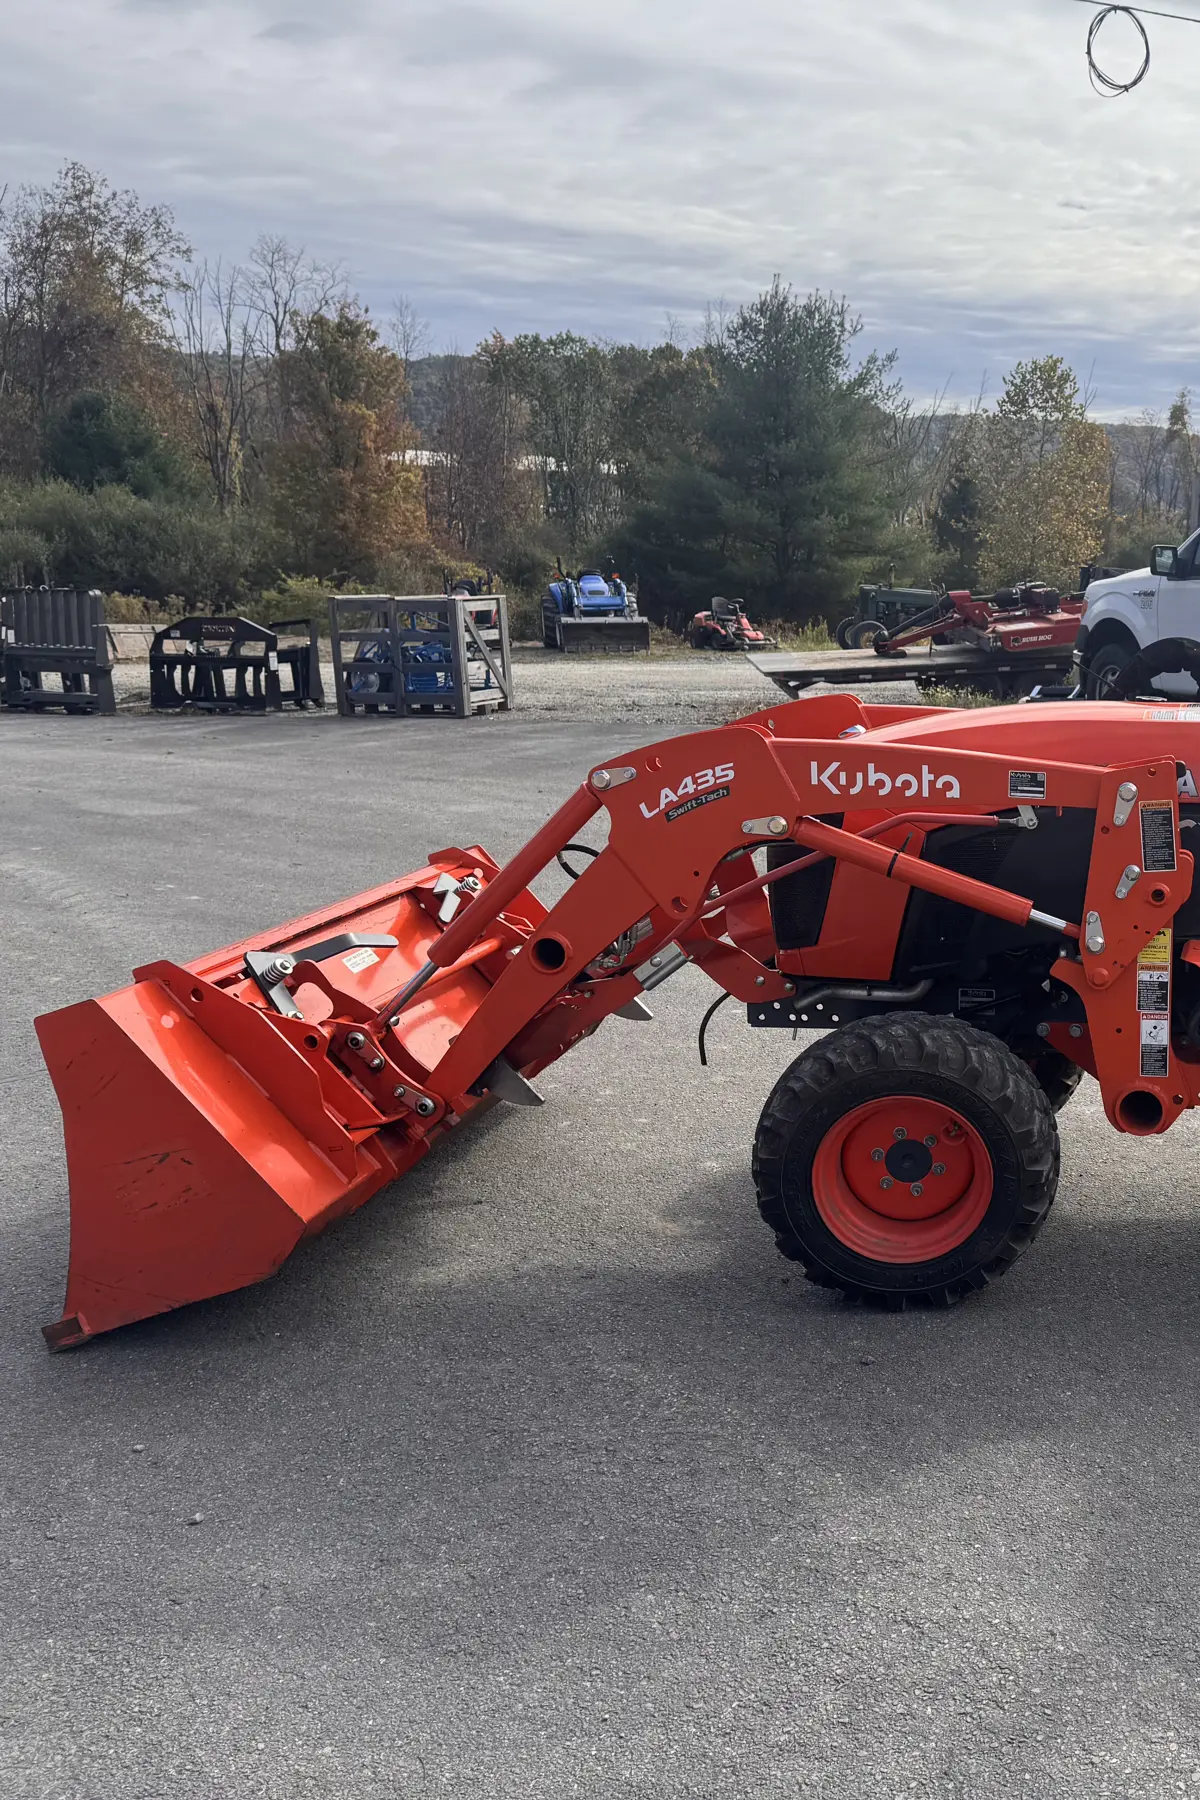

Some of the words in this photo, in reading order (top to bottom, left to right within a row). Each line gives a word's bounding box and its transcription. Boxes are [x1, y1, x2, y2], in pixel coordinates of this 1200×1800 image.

[638, 762, 736, 820] LA435
[810, 760, 961, 799] Kubota
[667, 787, 729, 820] Swift-Tach
